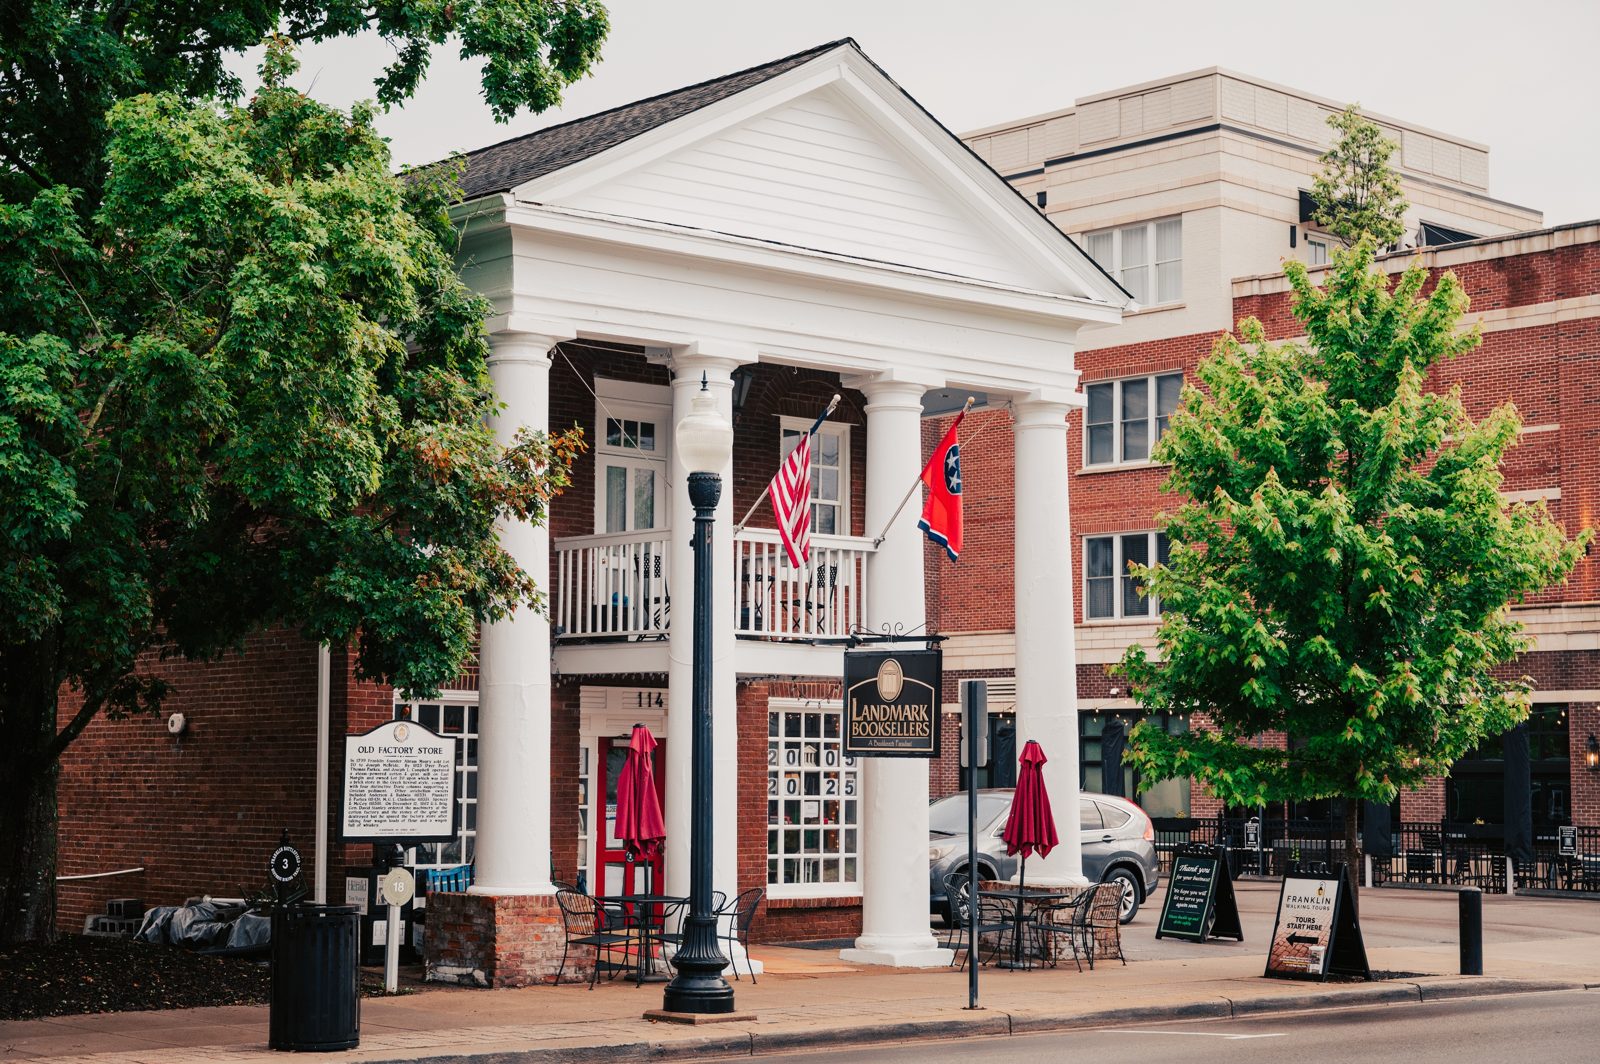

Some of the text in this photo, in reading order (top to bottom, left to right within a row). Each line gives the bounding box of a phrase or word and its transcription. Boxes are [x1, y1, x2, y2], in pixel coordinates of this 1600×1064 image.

[638, 691, 664, 708] 114
[852, 698, 929, 721] LANDMARK
[852, 722, 929, 736] BOOKSELLERS
[358, 746, 375, 754] OLD
[282, 858, 289, 869] 3
[1179, 864, 1198, 873] Thank
[393, 882, 404, 892] 18
[1286, 895, 1331, 905] FRANKLIN
